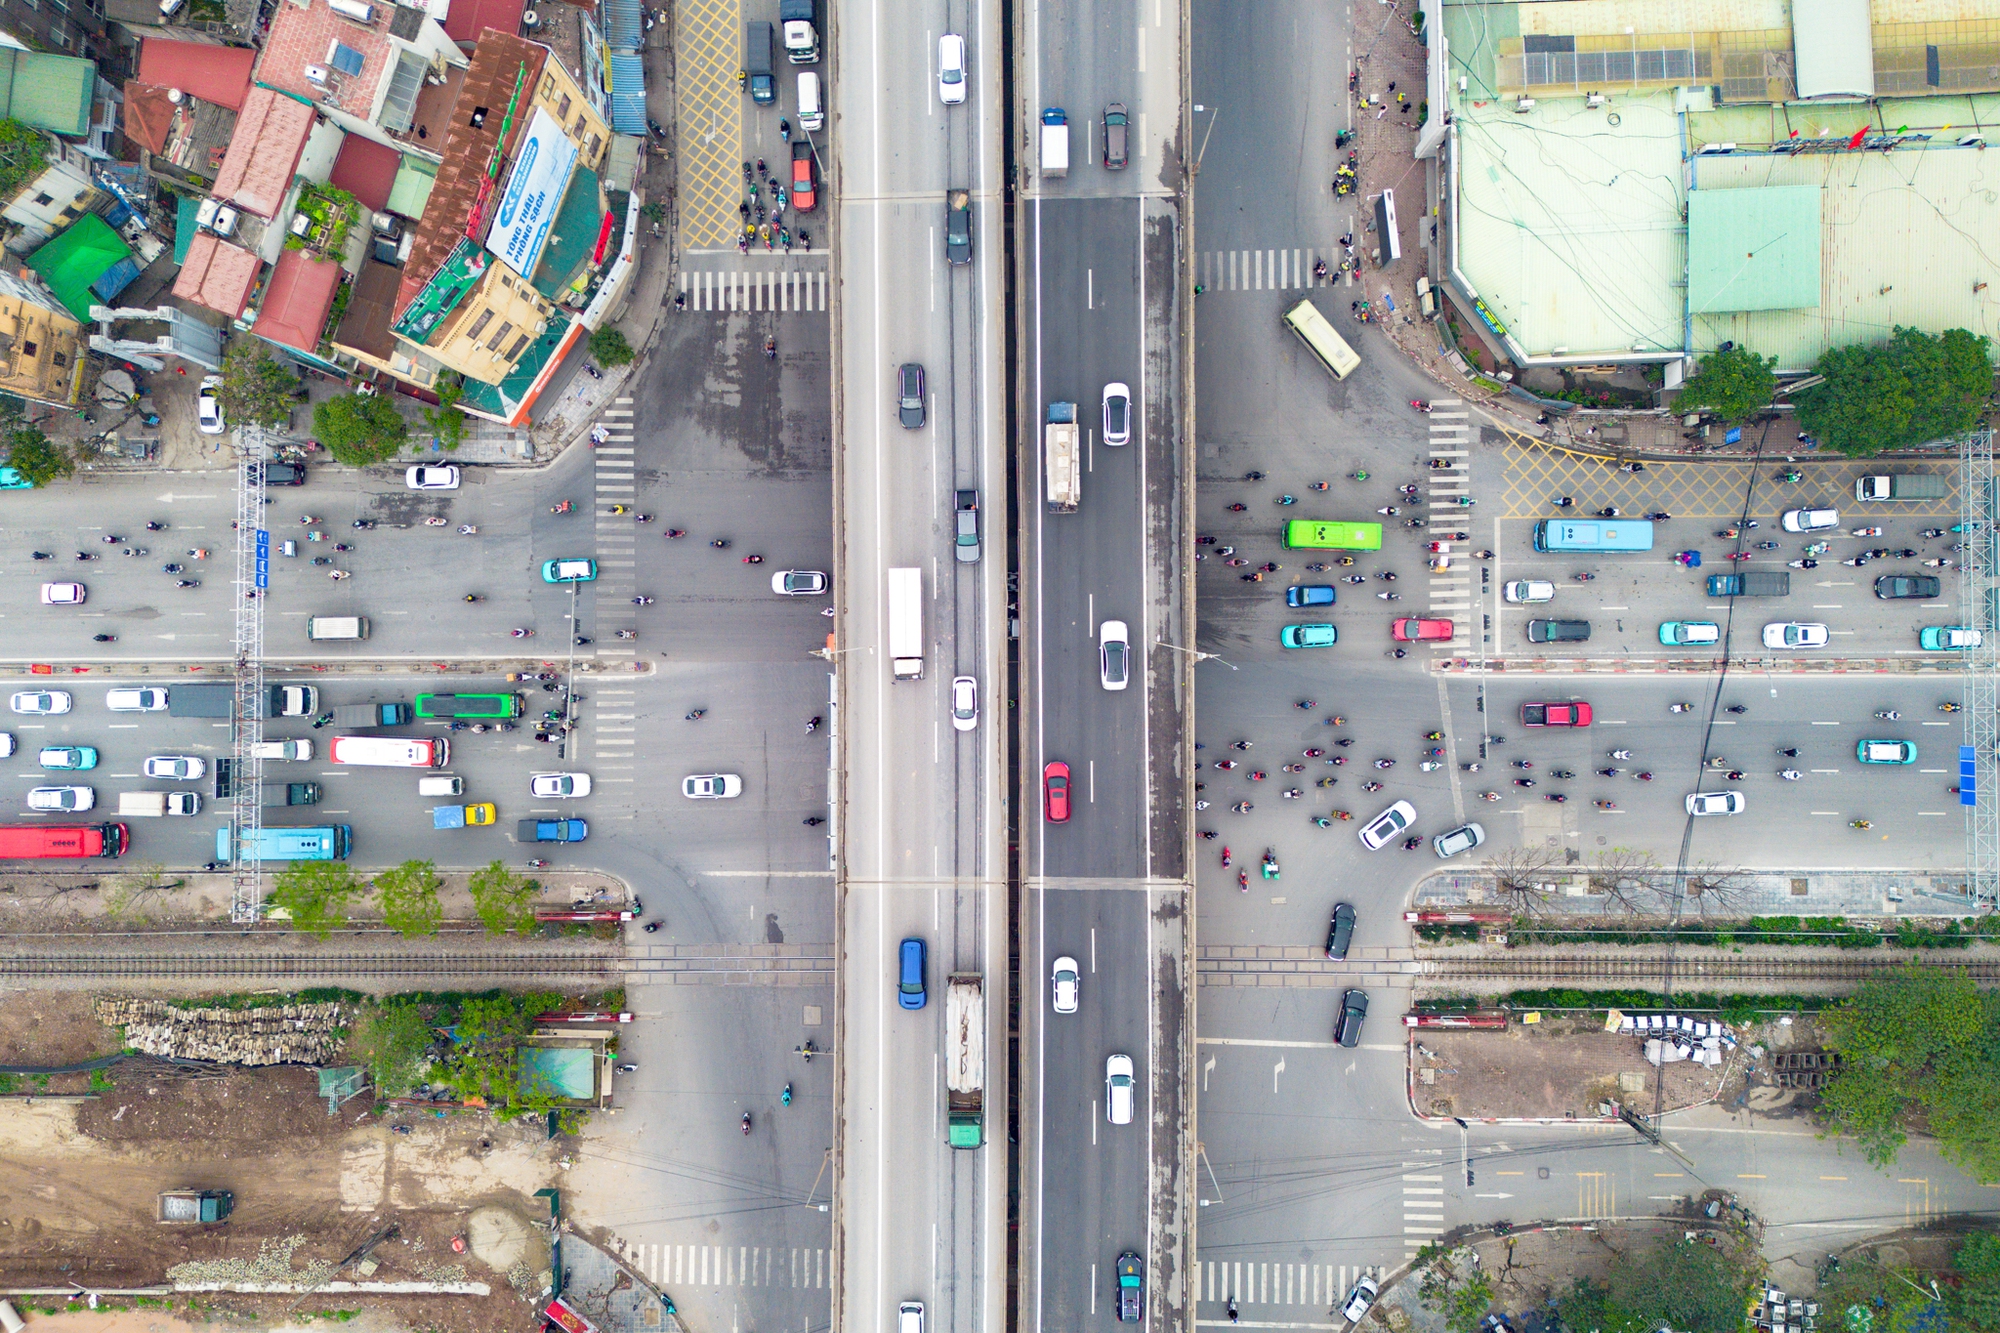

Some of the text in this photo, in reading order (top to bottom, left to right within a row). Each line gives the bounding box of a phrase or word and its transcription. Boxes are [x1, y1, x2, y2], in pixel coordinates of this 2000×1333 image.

[512, 141, 534, 192] ANH KHANG
[515, 145, 538, 196] CLEANROOM
[513, 190, 546, 264] PHÒNG SẠCH
